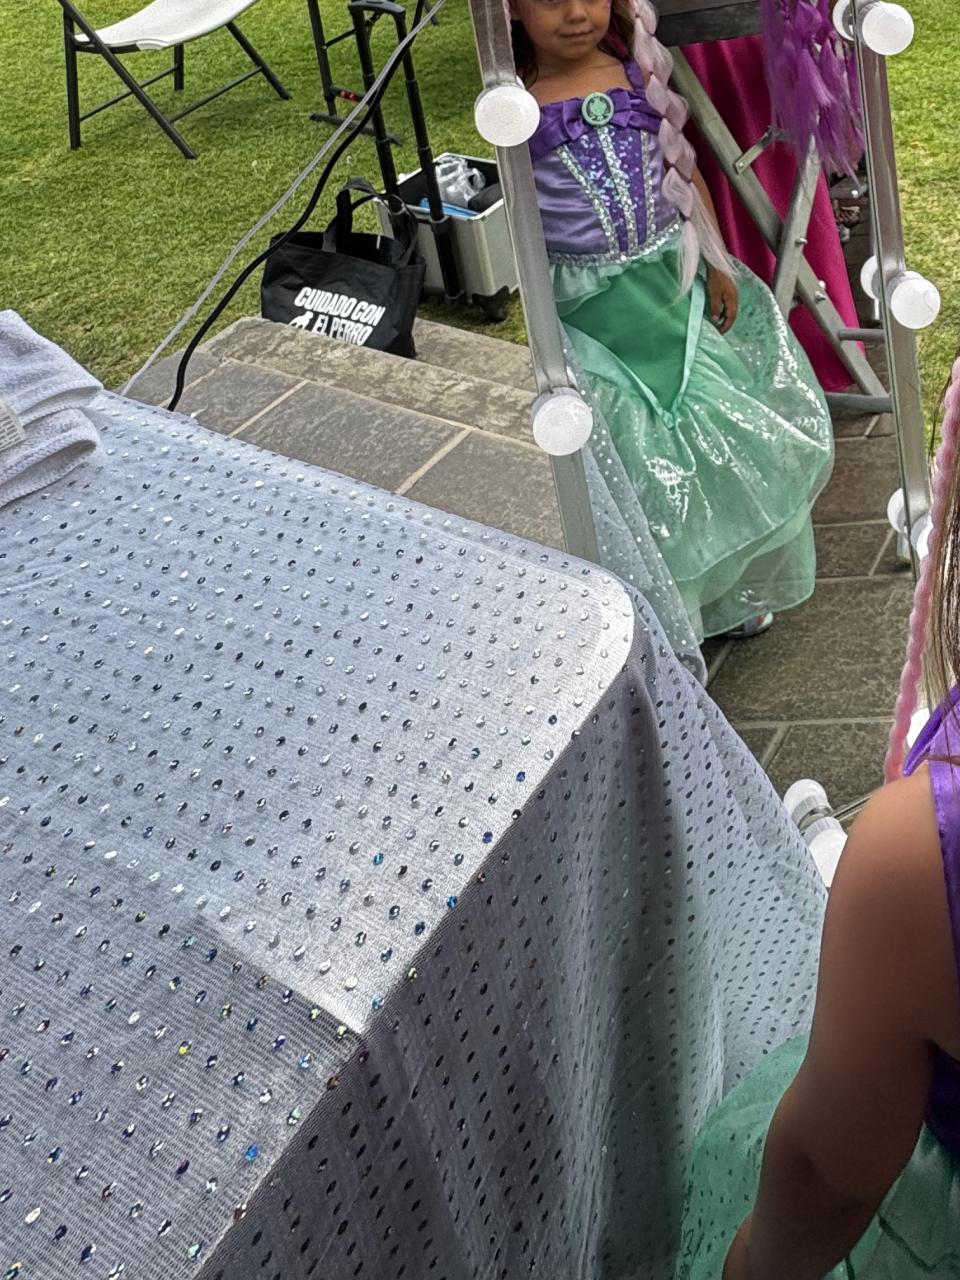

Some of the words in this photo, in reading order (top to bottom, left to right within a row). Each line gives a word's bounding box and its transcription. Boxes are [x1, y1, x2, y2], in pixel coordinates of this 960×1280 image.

[294, 286, 358, 318] CUIDADO
[350, 300, 386, 327] CON
[311, 314, 330, 336] EL
[328, 316, 374, 346] PERRO
